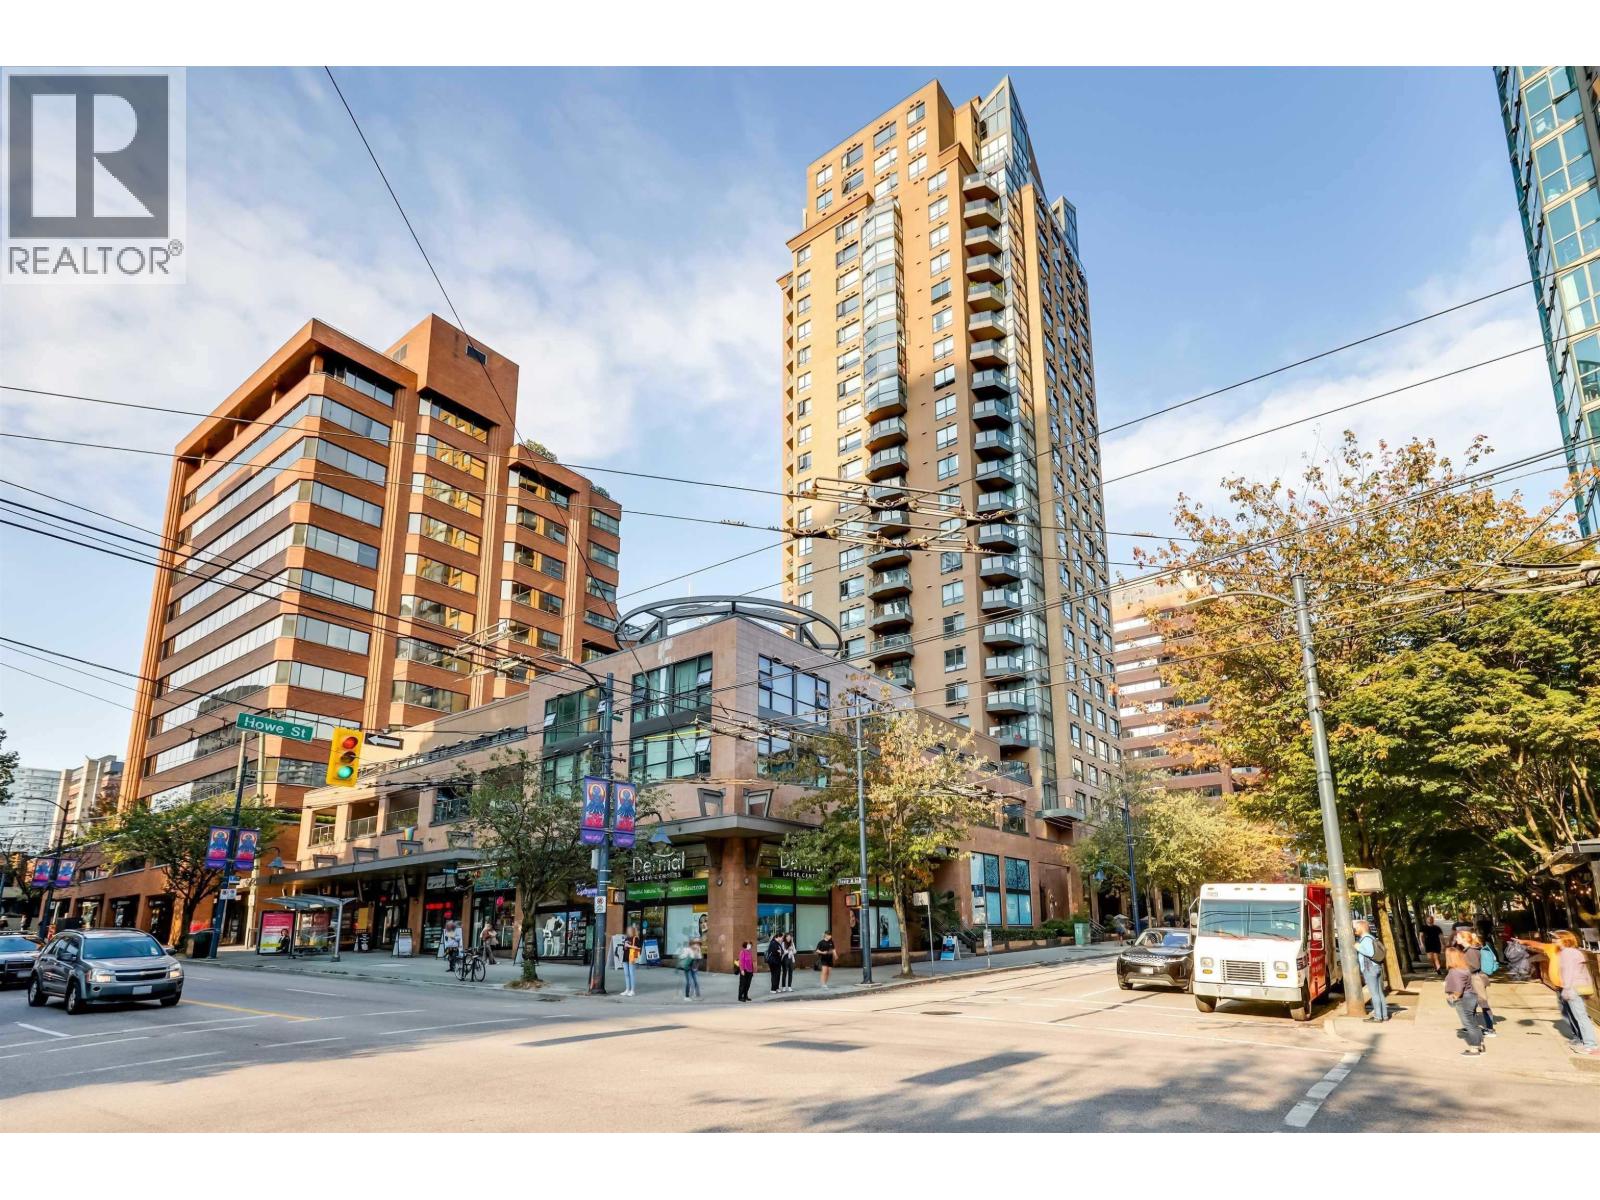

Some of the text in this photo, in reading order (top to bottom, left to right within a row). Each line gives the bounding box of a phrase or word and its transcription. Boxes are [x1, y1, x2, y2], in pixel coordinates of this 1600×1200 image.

[244, 716, 307, 739] Howe St
[632, 851, 686, 873] Demal
